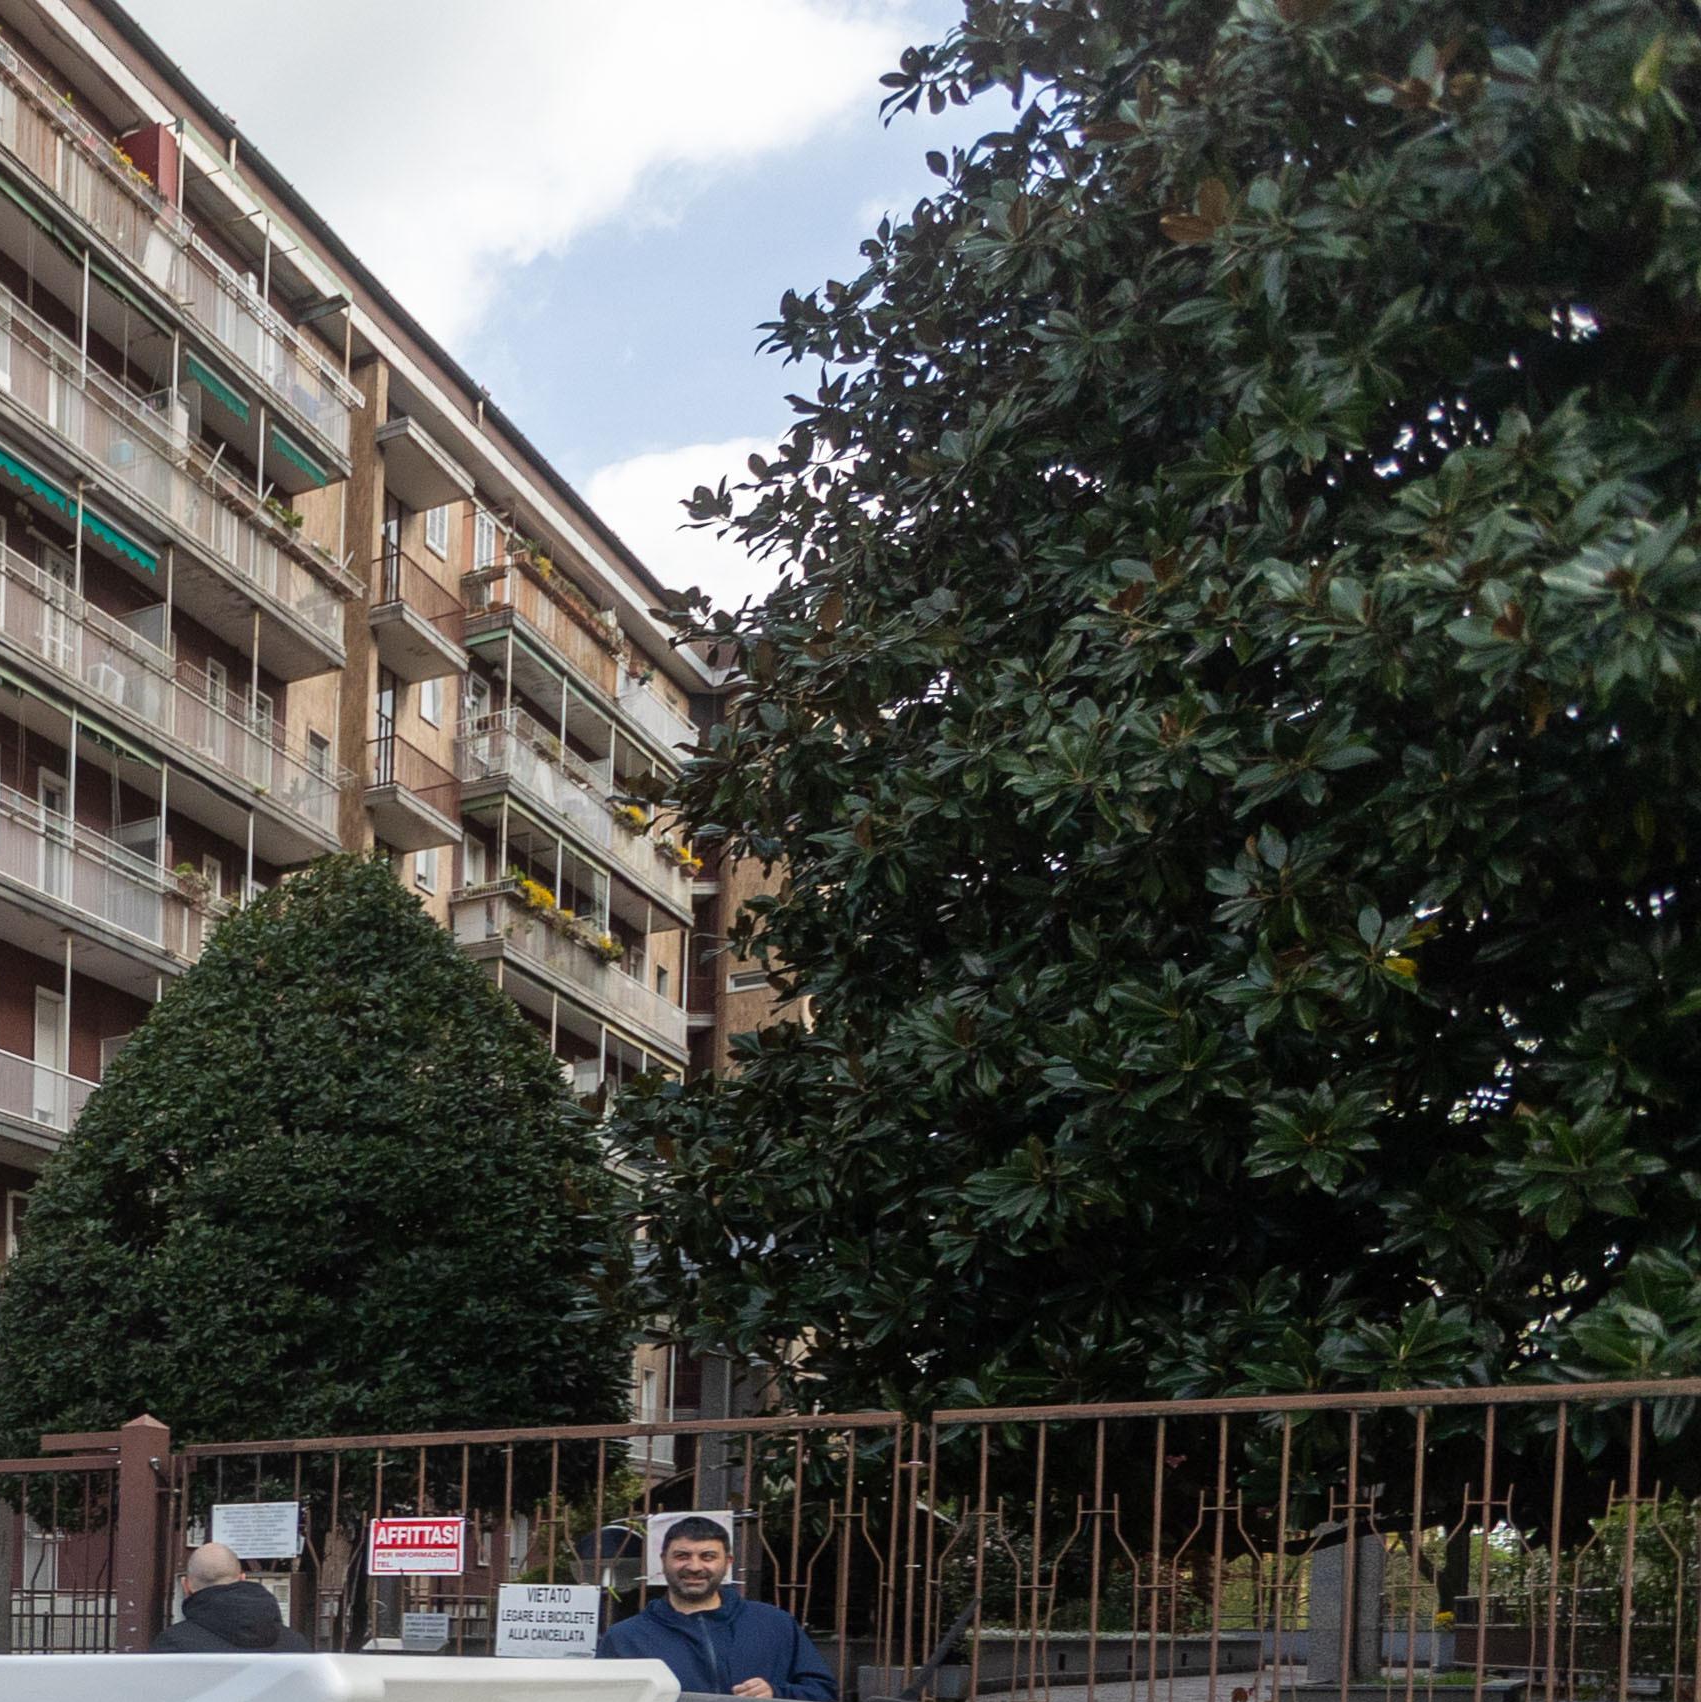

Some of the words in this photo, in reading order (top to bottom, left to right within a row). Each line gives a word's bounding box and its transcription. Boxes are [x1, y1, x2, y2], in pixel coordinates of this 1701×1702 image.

[376, 1526, 459, 1545] AFFITTASI
[527, 1587, 572, 1604] VIETATO
[501, 1609, 534, 1623] LEGARE
[536, 1610, 545, 1623] LE
[547, 1611, 596, 1625] BICICLETTE
[508, 1628, 529, 1640] ALLA
[531, 1628, 586, 1642] CANCELLATA
